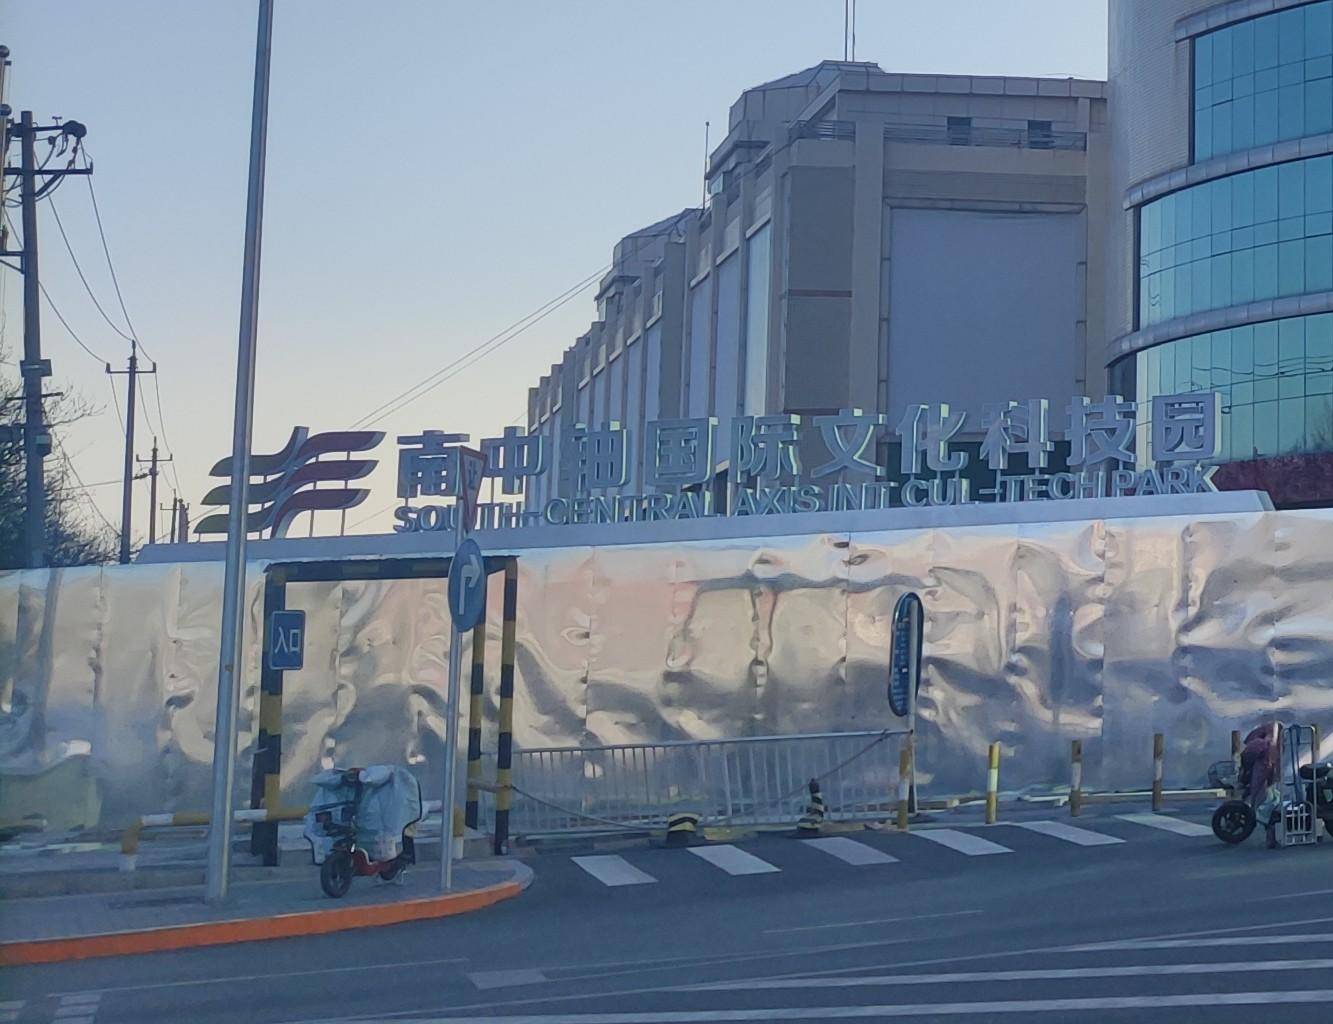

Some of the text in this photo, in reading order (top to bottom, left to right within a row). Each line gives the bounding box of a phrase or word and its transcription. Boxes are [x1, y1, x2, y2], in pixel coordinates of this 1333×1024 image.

[396, 391, 1222, 498] 南中轴国际文化科技园
[733, 483, 820, 518] AXIS
[827, 480, 898, 512] INT
[901, 469, 1106, 508] CUL-TECH
[1110, 464, 1219, 498] PARK
[273, 628, 301, 655] 入口
